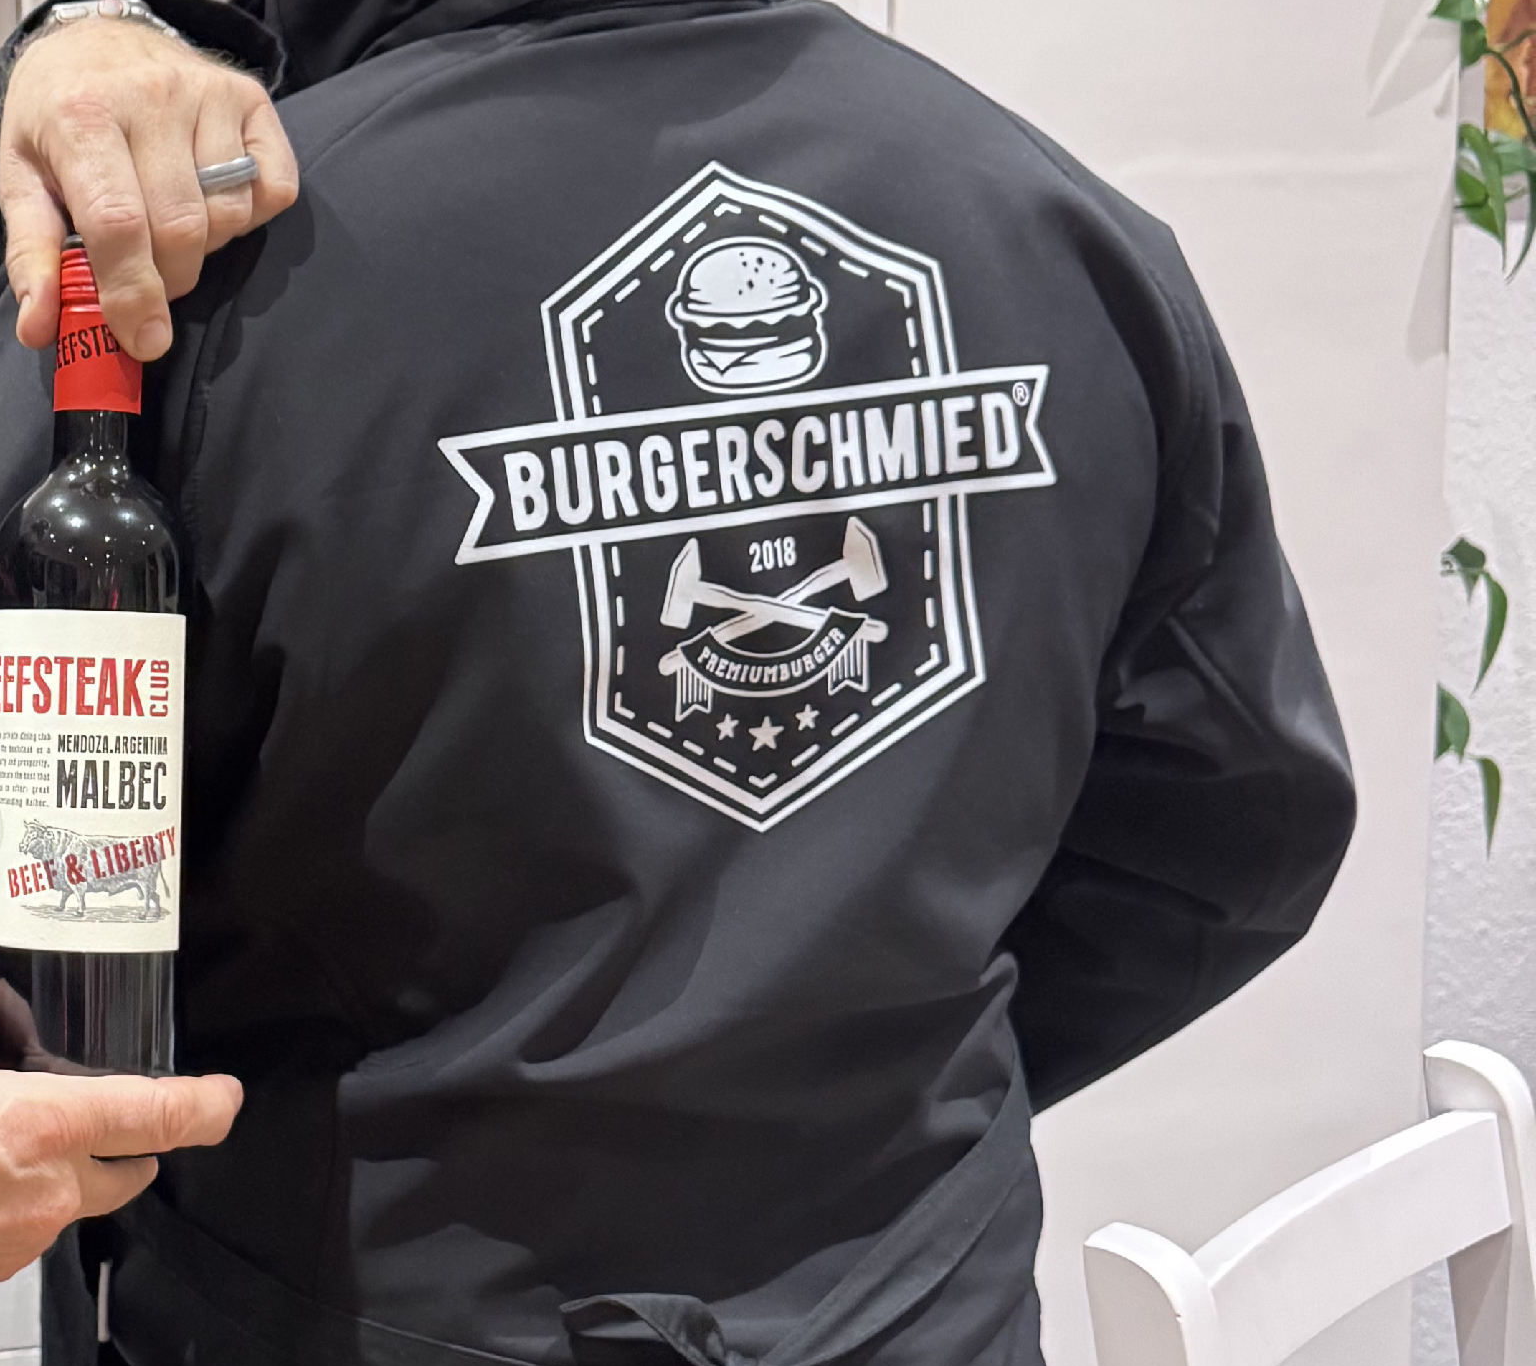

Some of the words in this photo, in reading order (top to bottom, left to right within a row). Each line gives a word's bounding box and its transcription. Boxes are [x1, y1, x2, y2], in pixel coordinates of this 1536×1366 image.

[748, 536, 797, 573] 2018
[696, 627, 846, 684] PREMIUMBURGER
[149, 659, 170, 717] CLUB
[56, 759, 168, 810] MALBEC
[7, 858, 57, 899] BEEF
[65, 852, 87, 886] &
[89, 825, 176, 880] LIBERTY
